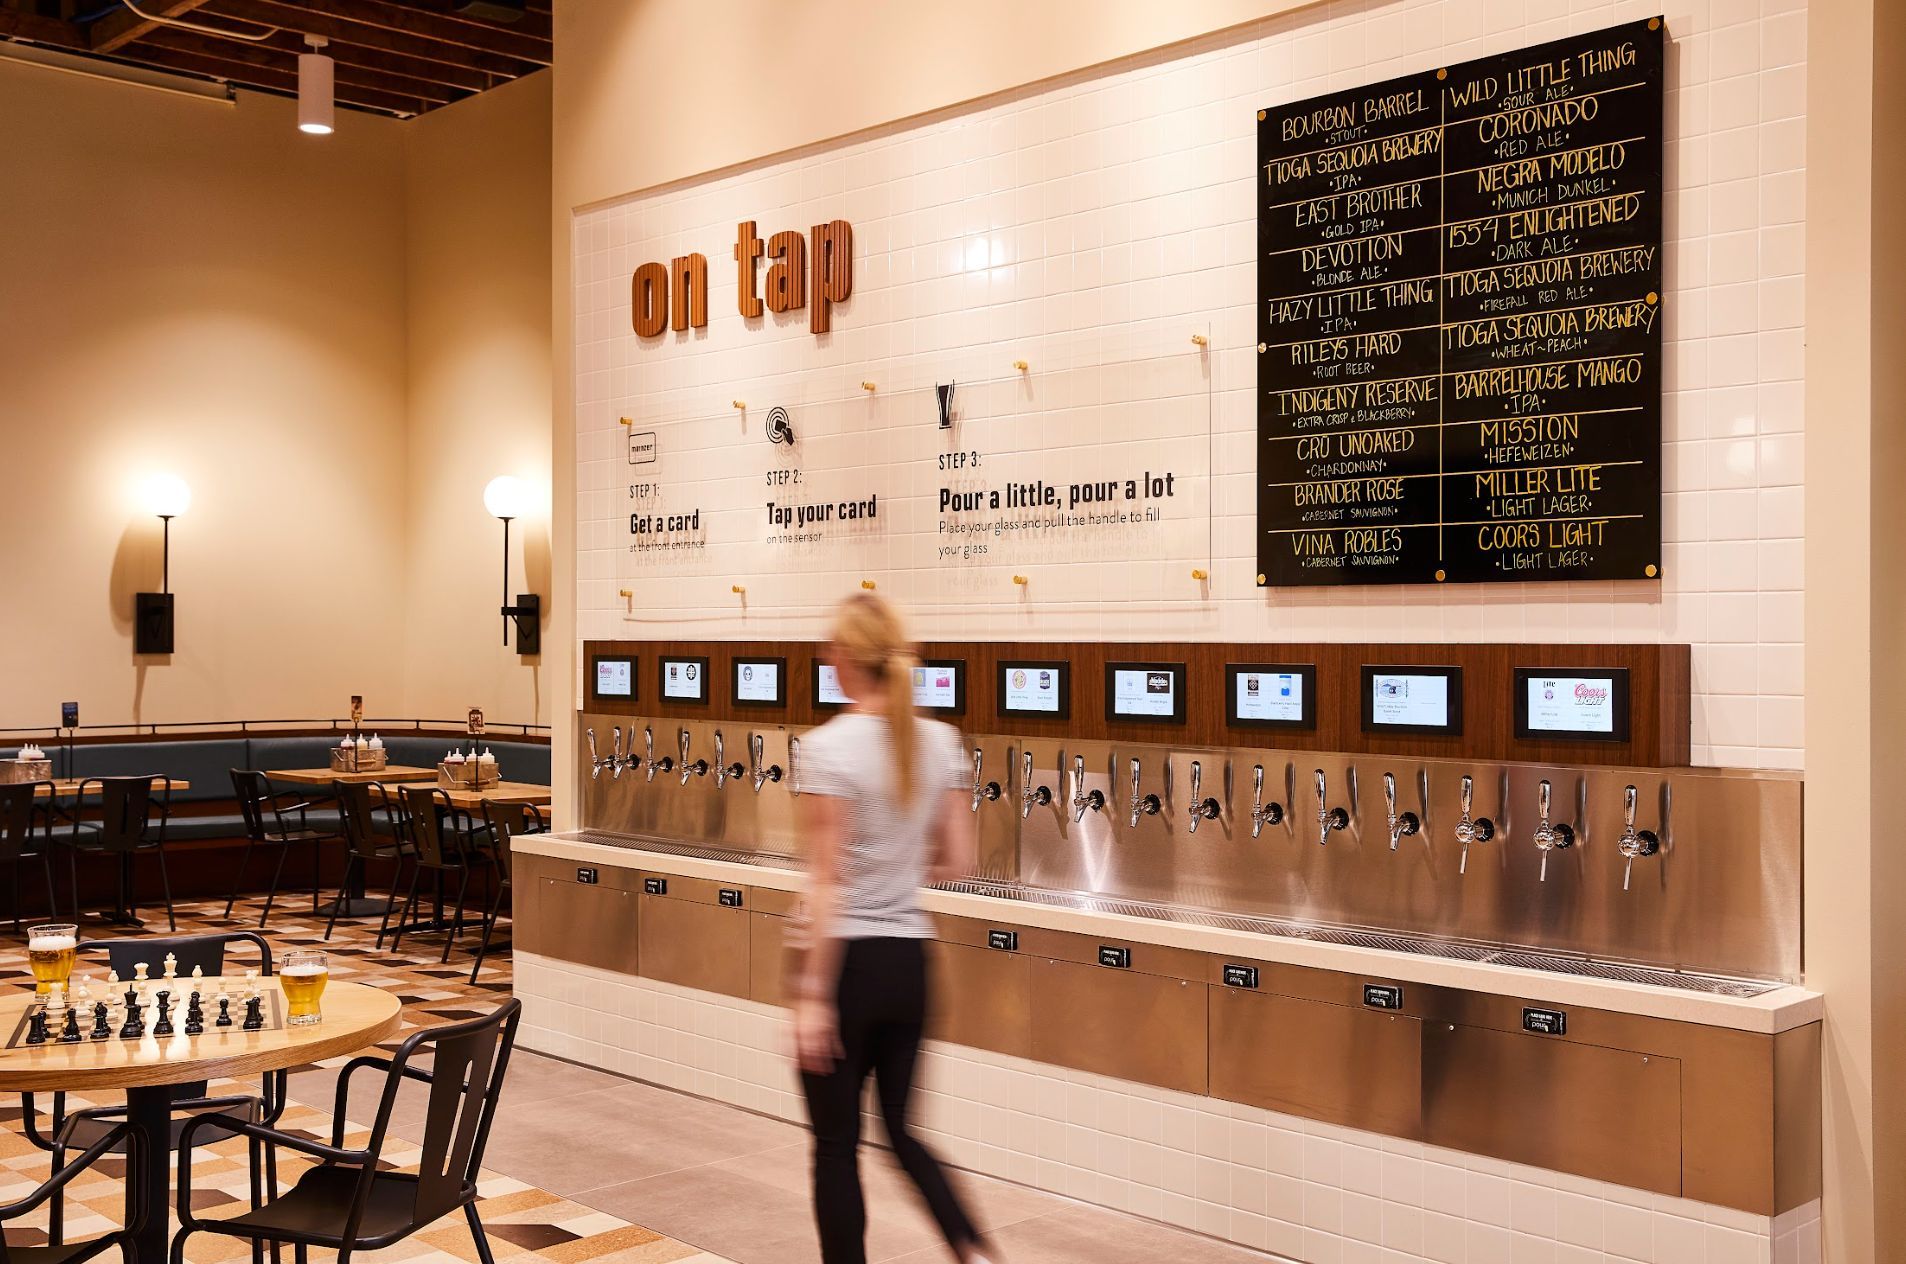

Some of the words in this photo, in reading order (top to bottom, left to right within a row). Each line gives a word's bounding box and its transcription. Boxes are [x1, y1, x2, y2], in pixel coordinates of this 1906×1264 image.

[1450, 78, 1498, 108] WILD
[1508, 58, 1571, 95] LITTLE
[1578, 42, 1636, 77] THING
[1504, 92, 1534, 111] SOUR
[1546, 84, 1568, 101] ALE
[1283, 102, 1355, 141] BOURBON
[1364, 90, 1429, 122] BARREL
[1479, 96, 1598, 143] CORONADO
[1330, 125, 1365, 144] STOUT
[1500, 139, 1528, 159] RED
[1536, 131, 1564, 151] ALE
[1263, 156, 1311, 185] TIOGA
[1317, 144, 1378, 173] SEQUOIA
[1382, 128, 1442, 162] BREWERY
[1479, 160, 1542, 193] NEGRA
[1550, 143, 1625, 179] MODELO
[1334, 174, 1357, 191] IPA
[1498, 187, 1548, 210] MUNICH
[1558, 178, 1610, 200] DUNKEL
[1296, 197, 1340, 227] EAST
[1348, 183, 1422, 218] BROTHER
[1326, 224, 1354, 238] GOLD
[1360, 219, 1379, 233] IPA
[1450, 218, 1498, 248] 1554
[1510, 194, 1640, 240] ENLIGHTENED
[1302, 233, 1402, 272] DEVOTION
[1497, 242, 1533, 262] DARK
[1541, 235, 1573, 256] ALE
[632, 252, 708, 337] on
[734, 219, 853, 334] tap
[1317, 270, 1354, 286] BLONDE
[1360, 266, 1382, 280] ALE
[1444, 270, 1500, 298] TIOGA
[1503, 257, 1573, 289] SEQUOIA
[1580, 247, 1655, 280] BREWERY
[1270, 298, 1313, 324] HAZY
[1318, 288, 1376, 318] LITTLE
[1380, 280, 1433, 308] THING
[1484, 296, 1528, 312] FIREFALL
[1538, 290, 1558, 303] RED
[1566, 286, 1588, 300] ALE
[1324, 317, 1352, 333] IPA
[1442, 320, 1499, 349] TIOGA
[1504, 312, 1579, 340] SEQUOIA
[1585, 303, 1658, 334] BREWERY
[1291, 339, 1348, 365] RILEYS
[1356, 333, 1401, 358] HARD
[1317, 363, 1341, 378] ROOT
[1346, 362, 1370, 375] BEER
[1455, 365, 1569, 399] BARRELHOUSE
[1578, 359, 1641, 388] MANGO
[1277, 386, 1358, 415] INDIGENY
[1366, 378, 1438, 406] RESERVE
[1510, 394, 1540, 414] IPA
[1297, 415, 1324, 428] EXTRA
[1326, 412, 1348, 426] CRISP
[1358, 408, 1411, 422] BLACKBERRY
[1480, 415, 1578, 446] MISSION
[1340, 430, 1414, 457] UNOAKED
[1489, 442, 1570, 464] HEFEWEIZEN
[939, 453, 966, 470] STEP
[971, 452, 982, 467] 3:
[1311, 459, 1383, 477] CHARDONNAY
[630, 484, 649, 498] STEP
[653, 484, 659, 496] 1:
[767, 470, 789, 486] STEP
[794, 469, 802, 483] 2:
[1476, 470, 1550, 498] MILLER
[1557, 466, 1602, 493] LITE
[940, 488, 983, 512] Pour
[990, 490, 999, 509] a
[1007, 481, 1062, 509] little,
[1070, 481, 1117, 509] pour
[1125, 480, 1136, 499] a
[1145, 472, 1174, 498] lot
[1294, 480, 1360, 506] BRANDER
[767, 502, 792, 529] Tap
[798, 504, 833, 528] your
[839, 494, 876, 519] card
[1305, 509, 1344, 521] CABERNET
[1350, 506, 1394, 518] SAUVIGNON
[1492, 497, 1535, 518] LIGHT
[1543, 495, 1589, 515] LAGER
[631, 514, 651, 534] Get
[656, 517, 663, 532] a
[668, 508, 699, 531] card
[940, 520, 966, 534] Place
[969, 522, 992, 536] your
[995, 517, 1019, 536] glass
[1022, 515, 1040, 529] and
[1045, 514, 1064, 532] pull
[1067, 514, 1085, 526] the
[1089, 510, 1126, 524] handle
[1130, 510, 1142, 522] to
[1146, 507, 1160, 522] fill
[630, 544, 636, 552] at
[639, 541, 650, 552] the
[651, 540, 669, 551] front
[672, 540, 704, 550] entrance
[767, 536, 776, 544] on
[779, 534, 792, 543] the
[795, 533, 822, 542] sensor
[1292, 534, 1334, 555] VINA
[1344, 529, 1402, 554] ROBLES
[1478, 524, 1540, 550] COORS
[1550, 520, 1609, 548] LIGHT
[939, 545, 961, 559] your
[964, 542, 988, 558] glass
[1306, 556, 1346, 568] CABERNET
[1352, 555, 1394, 566] SAUVIGNON
[1502, 553, 1543, 570] LIGHT
[1549, 550, 1588, 569] LAGER
[1574, 683, 1607, 698] Coors
